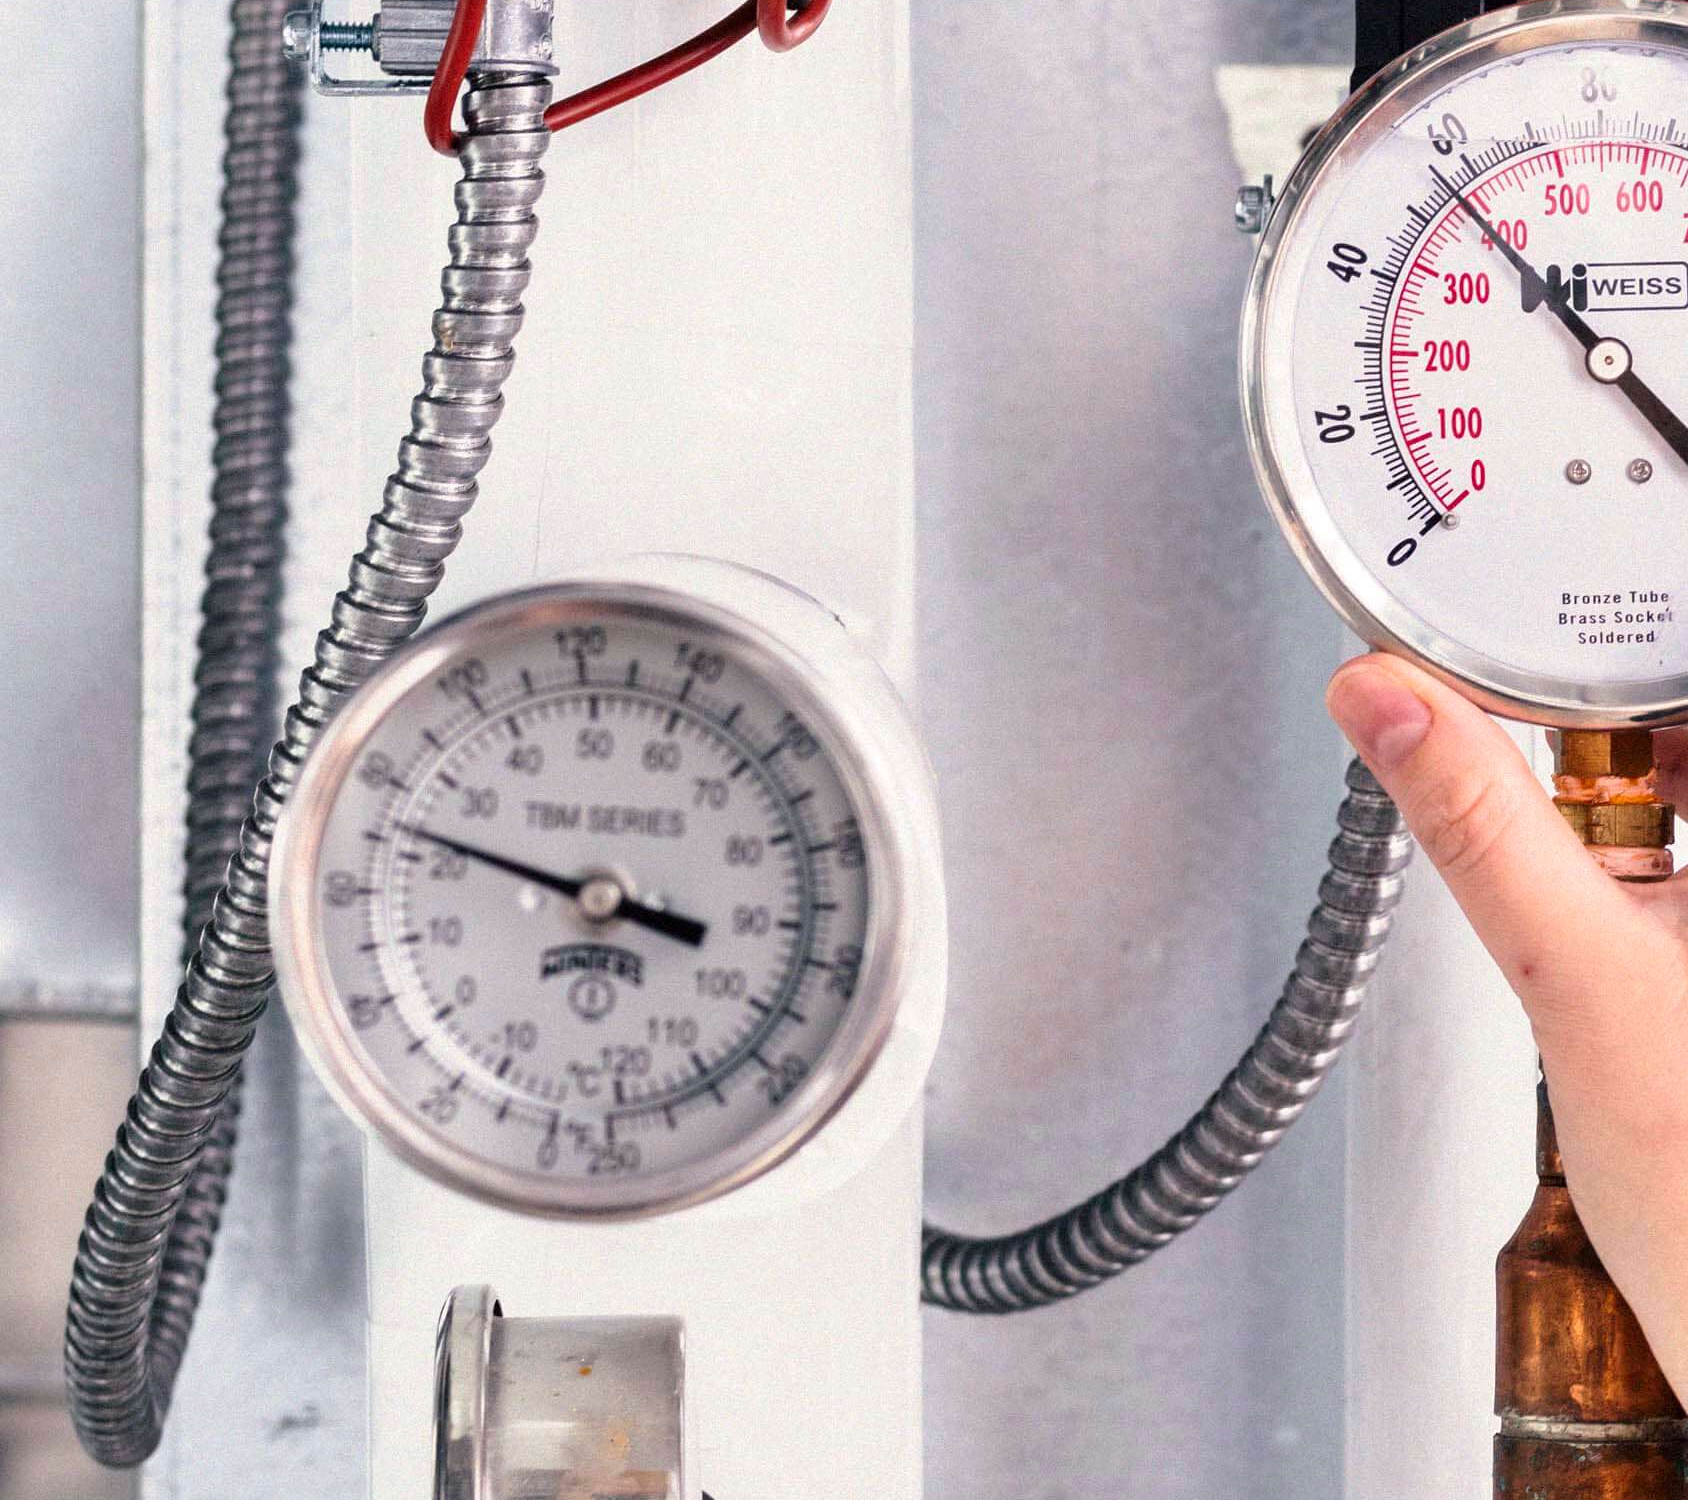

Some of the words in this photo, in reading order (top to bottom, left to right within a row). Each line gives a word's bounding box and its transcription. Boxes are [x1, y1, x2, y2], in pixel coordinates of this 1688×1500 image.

[1426, 111, 1468, 153] 60
[1545, 183, 1590, 216] 500
[1616, 180, 1663, 213] 600
[1480, 219, 1528, 251] 400
[1326, 241, 1368, 285] 40
[1443, 272, 1490, 305] 300
[1593, 274, 1682, 296] WEISS
[1423, 340, 1470, 373] 200
[1314, 403, 1355, 444] 20
[1437, 407, 1483, 439] 100
[1470, 460, 1486, 491] 0
[1386, 538, 1417, 568] 0
[1561, 591, 1622, 605] Bronze
[1630, 590, 1669, 604] Tube
[1558, 610, 1608, 625] Brass
[554, 627, 607, 657] 120
[1577, 630, 1656, 644] Soldered
[505, 743, 544, 774] 40
[643, 742, 681, 771] 60
[577, 729, 612, 760] 50
[586, 804, 686, 838] SERIES
[733, 906, 770, 935] 90
[697, 971, 745, 1000] 100
[647, 1017, 698, 1047] 110
